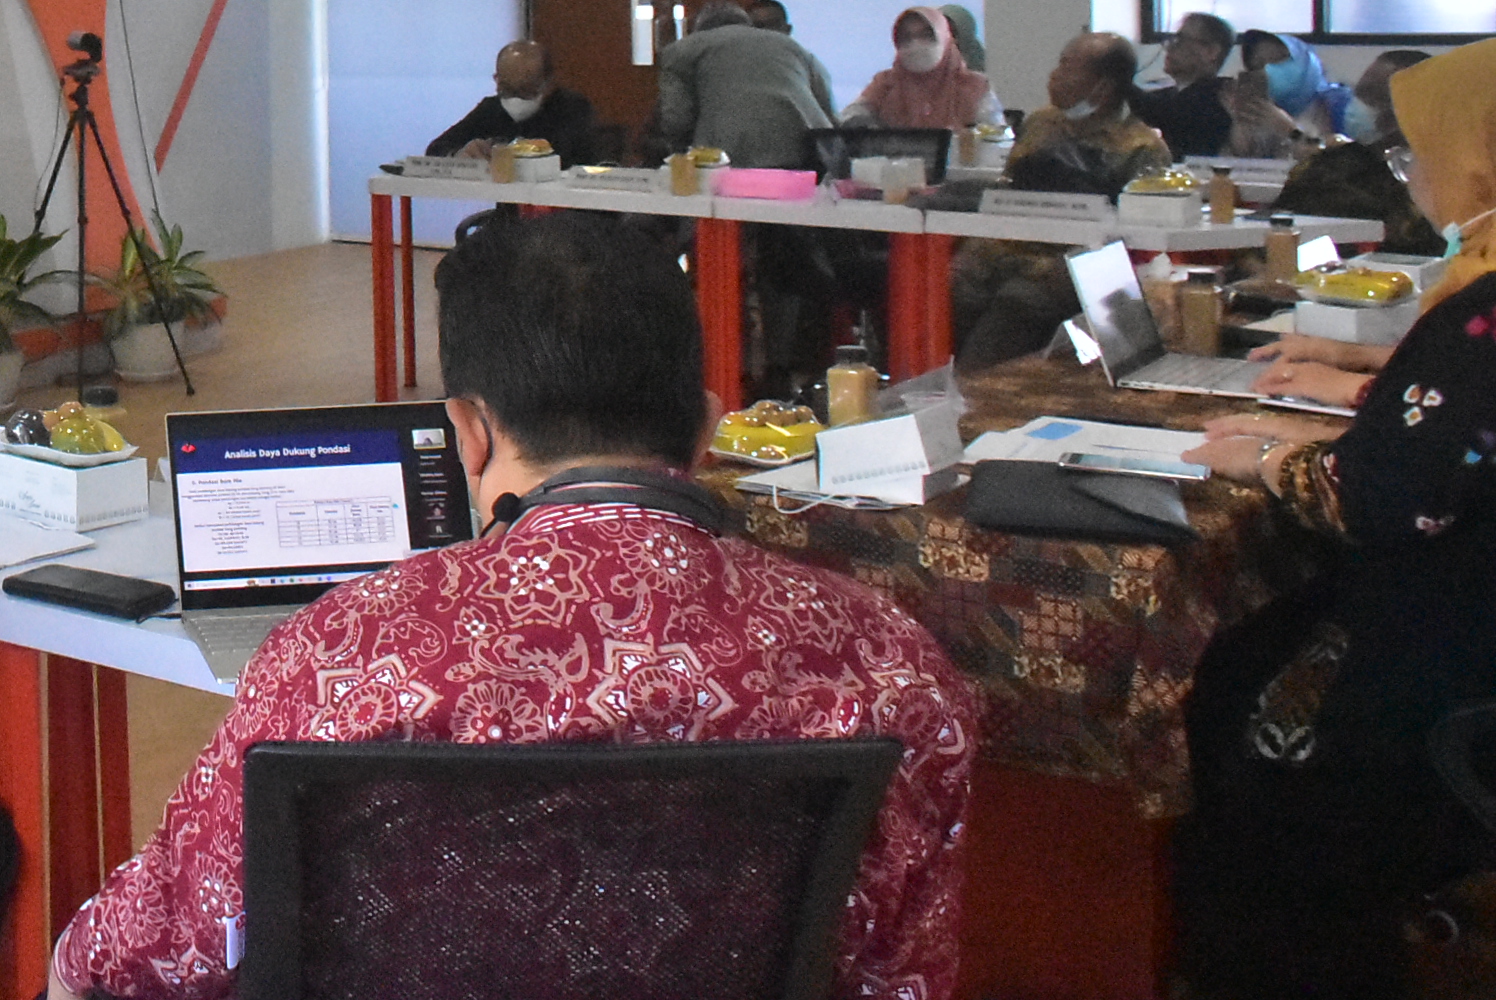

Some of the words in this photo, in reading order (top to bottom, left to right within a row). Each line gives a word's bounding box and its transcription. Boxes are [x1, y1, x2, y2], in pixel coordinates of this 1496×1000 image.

[224, 450, 257, 459] Analisis
[259, 448, 280, 458] Daya
[282, 446, 316, 458] Dukung
[318, 444, 351, 454] Pondasi
